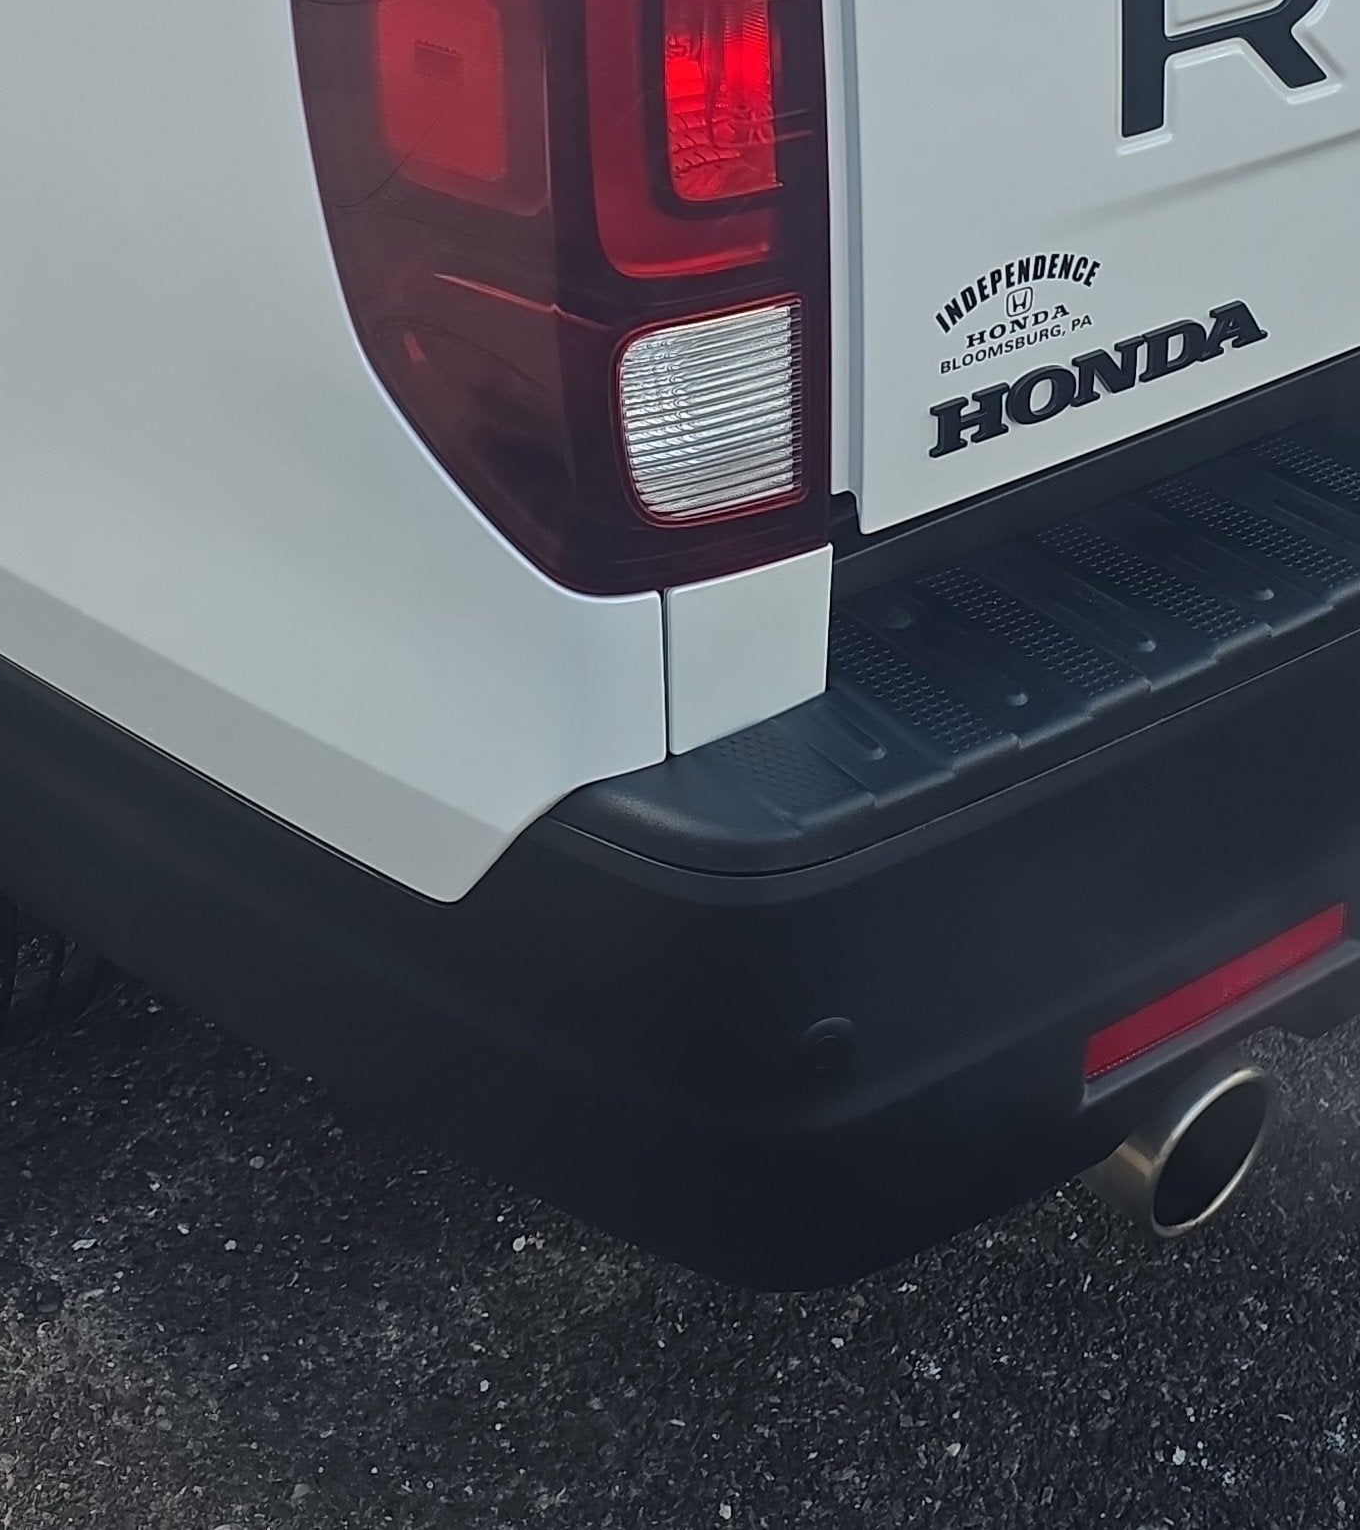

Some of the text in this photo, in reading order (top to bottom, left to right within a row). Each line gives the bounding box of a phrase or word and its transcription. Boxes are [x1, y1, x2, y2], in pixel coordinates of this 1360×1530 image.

[935, 253, 1101, 334] INDEPENDENCE
[966, 304, 1070, 349] HONDA
[929, 300, 1269, 458] HONDA
[940, 314, 1093, 374] BLOOMSBURG, PA
